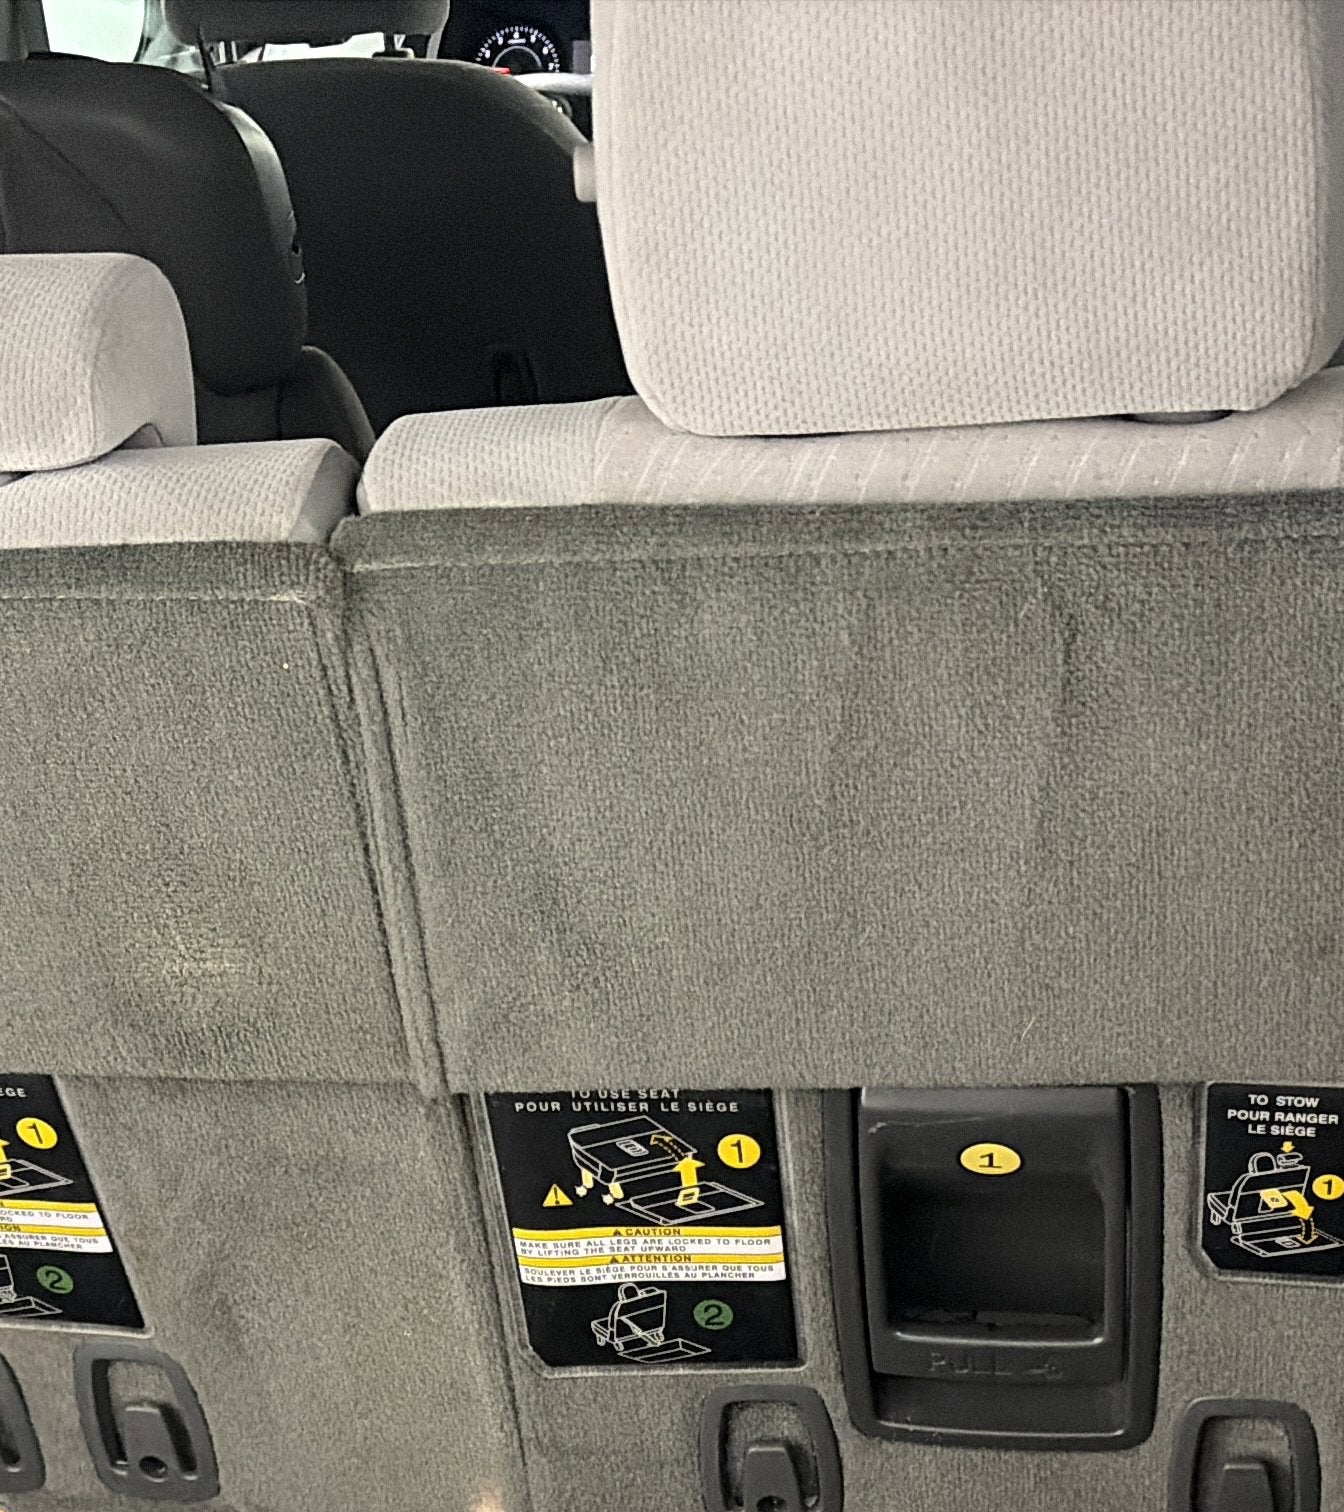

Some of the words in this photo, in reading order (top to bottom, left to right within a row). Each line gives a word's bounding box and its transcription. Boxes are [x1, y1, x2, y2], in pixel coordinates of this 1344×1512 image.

[598, 1088, 631, 1099] USE
[638, 1088, 680, 1099] SEAT
[514, 1101, 561, 1112] POUR
[572, 1101, 649, 1112] UTILISER
[660, 1101, 680, 1112] LE
[688, 1100, 739, 1113] SIÈGE
[1248, 1094, 1269, 1106] TO
[1275, 1096, 1320, 1108] STOW
[1227, 1108, 1271, 1121] POUR
[1274, 1111, 1339, 1125] RANGER
[30, 1122, 44, 1144] 1
[1247, 1123, 1267, 1135] LE
[1270, 1123, 1317, 1138] SIÈGE
[729, 1139, 743, 1164] 1
[978, 1152, 1002, 1169] 1
[1324, 1179, 1334, 1195] 1
[625, 1228, 681, 1236] CAUTION
[519, 1241, 548, 1249] MAKE
[553, 1241, 581, 1249] SURE
[610, 1238, 638, 1246] LEGS
[735, 1238, 771, 1246] FLOOR
[537, 1248, 580, 1257] LIFTING
[584, 1247, 605, 1255] THE
[640, 1245, 687, 1253] UPWARD
[622, 1254, 692, 1263] ATTENTION
[524, 1267, 575, 1276] SOULEVER
[579, 1268, 592, 1276] LE
[722, 1264, 743, 1272] QUE
[46, 1272, 64, 1291] 2
[546, 1276, 576, 1284] PIEDS
[580, 1275, 607, 1283] SONT
[703, 1303, 725, 1326] 2
